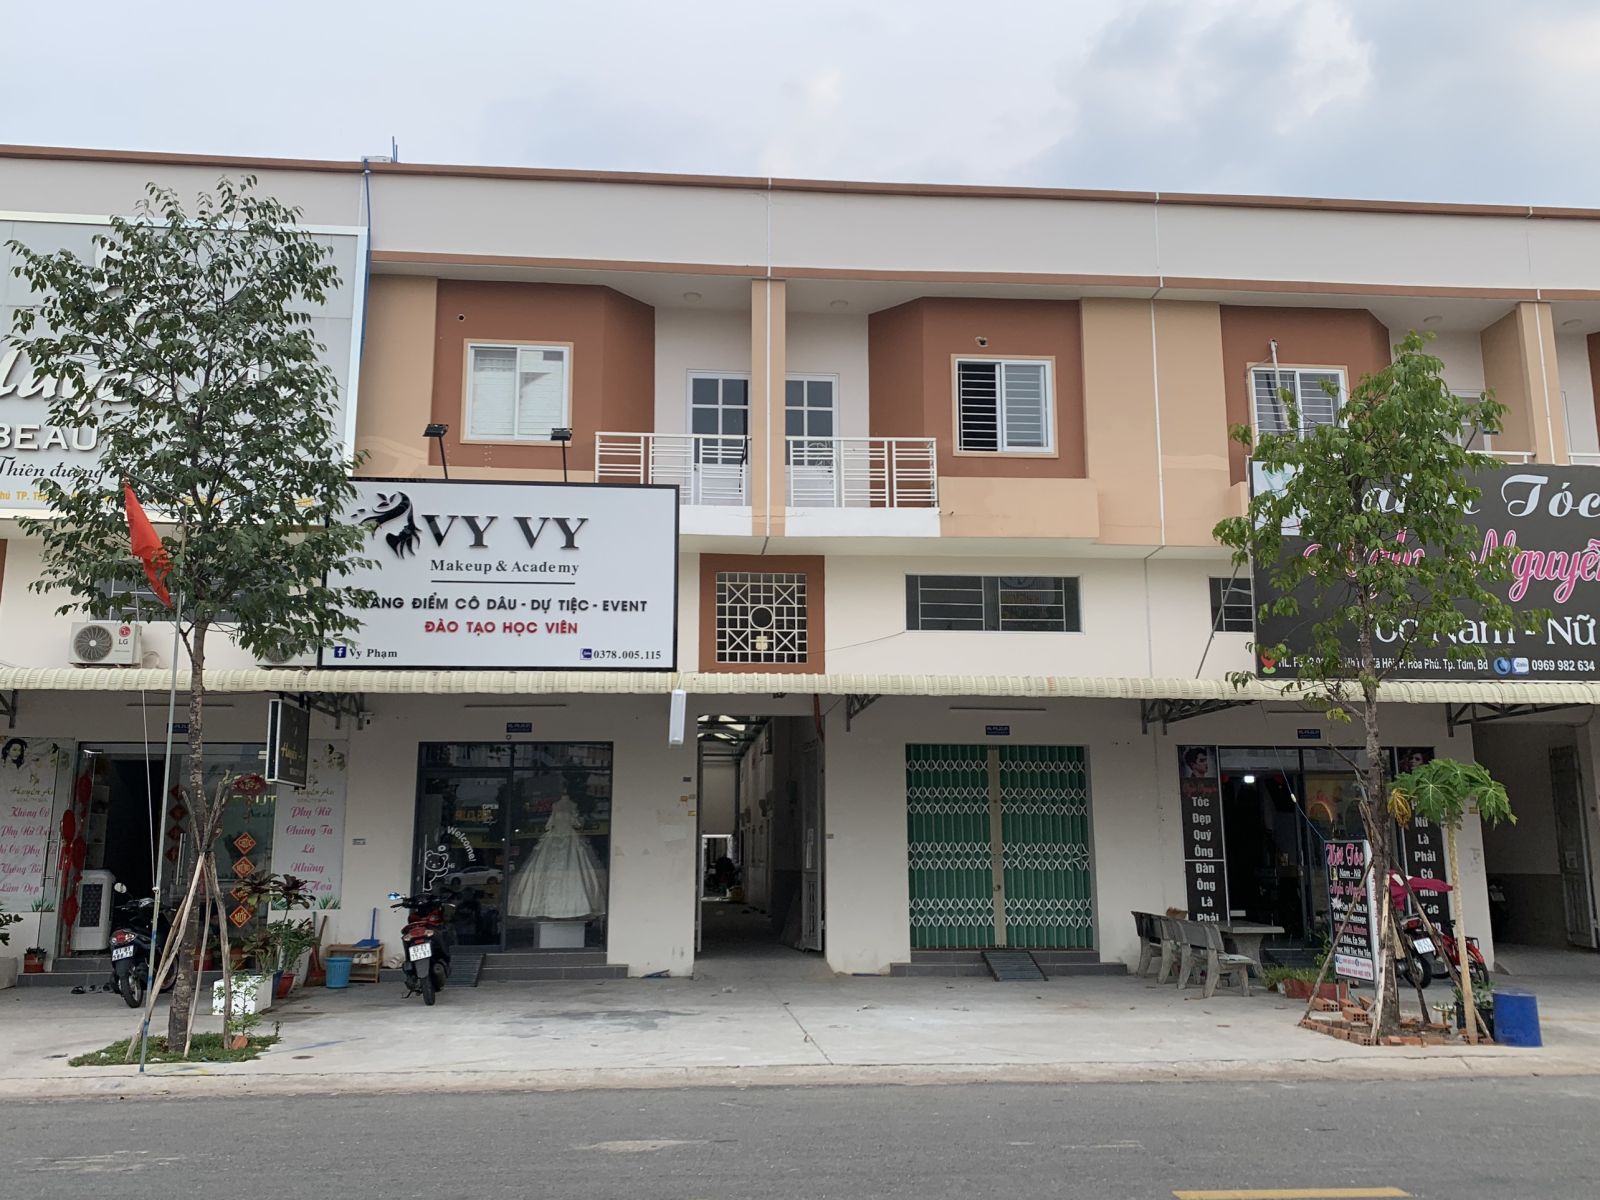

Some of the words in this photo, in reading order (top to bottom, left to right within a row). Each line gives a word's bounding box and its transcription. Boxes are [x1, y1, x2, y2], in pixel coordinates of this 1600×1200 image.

[1501, 474, 1600, 518] Tóc
[421, 514, 499, 549] VY
[513, 516, 589, 551] VY
[430, 559, 492, 575] Makeup
[495, 560, 507, 573] &
[511, 561, 580, 576] Academy
[412, 591, 449, 610] ĐIỂM
[455, 595, 480, 610] CÔ
[487, 595, 517, 610] DÂU
[531, 598, 552, 614] DỰ
[558, 597, 589, 614] TIỆC
[602, 600, 648, 612] EVENT
[425, 618, 459, 633] ĐÀO
[466, 621, 496, 636] TẠO
[503, 621, 538, 637] HỌC
[545, 620, 578, 634] VIÊN
[1546, 614, 1597, 646] Nữ
[349, 648, 362, 659] Vy
[367, 648, 398, 660] Phạm
[593, 650, 661, 660] 0378.005.115
[1532, 659, 1555, 671] 0969
[1557, 660, 1576, 671] 982
[1577, 660, 1596, 671] 634
[1191, 796, 1210, 807] Tóc
[1192, 813, 1212, 826] Đẹp
[1193, 829, 1212, 842] Quý
[1417, 833, 1430, 845] Là
[447, 826, 477, 862] Welcome!
[1194, 844, 1214, 858] Ông
[1414, 849, 1437, 862] Phải
[1195, 862, 1216, 874] Đàn
[1196, 878, 1216, 892] Ông
[1201, 896, 1214, 907] Là
